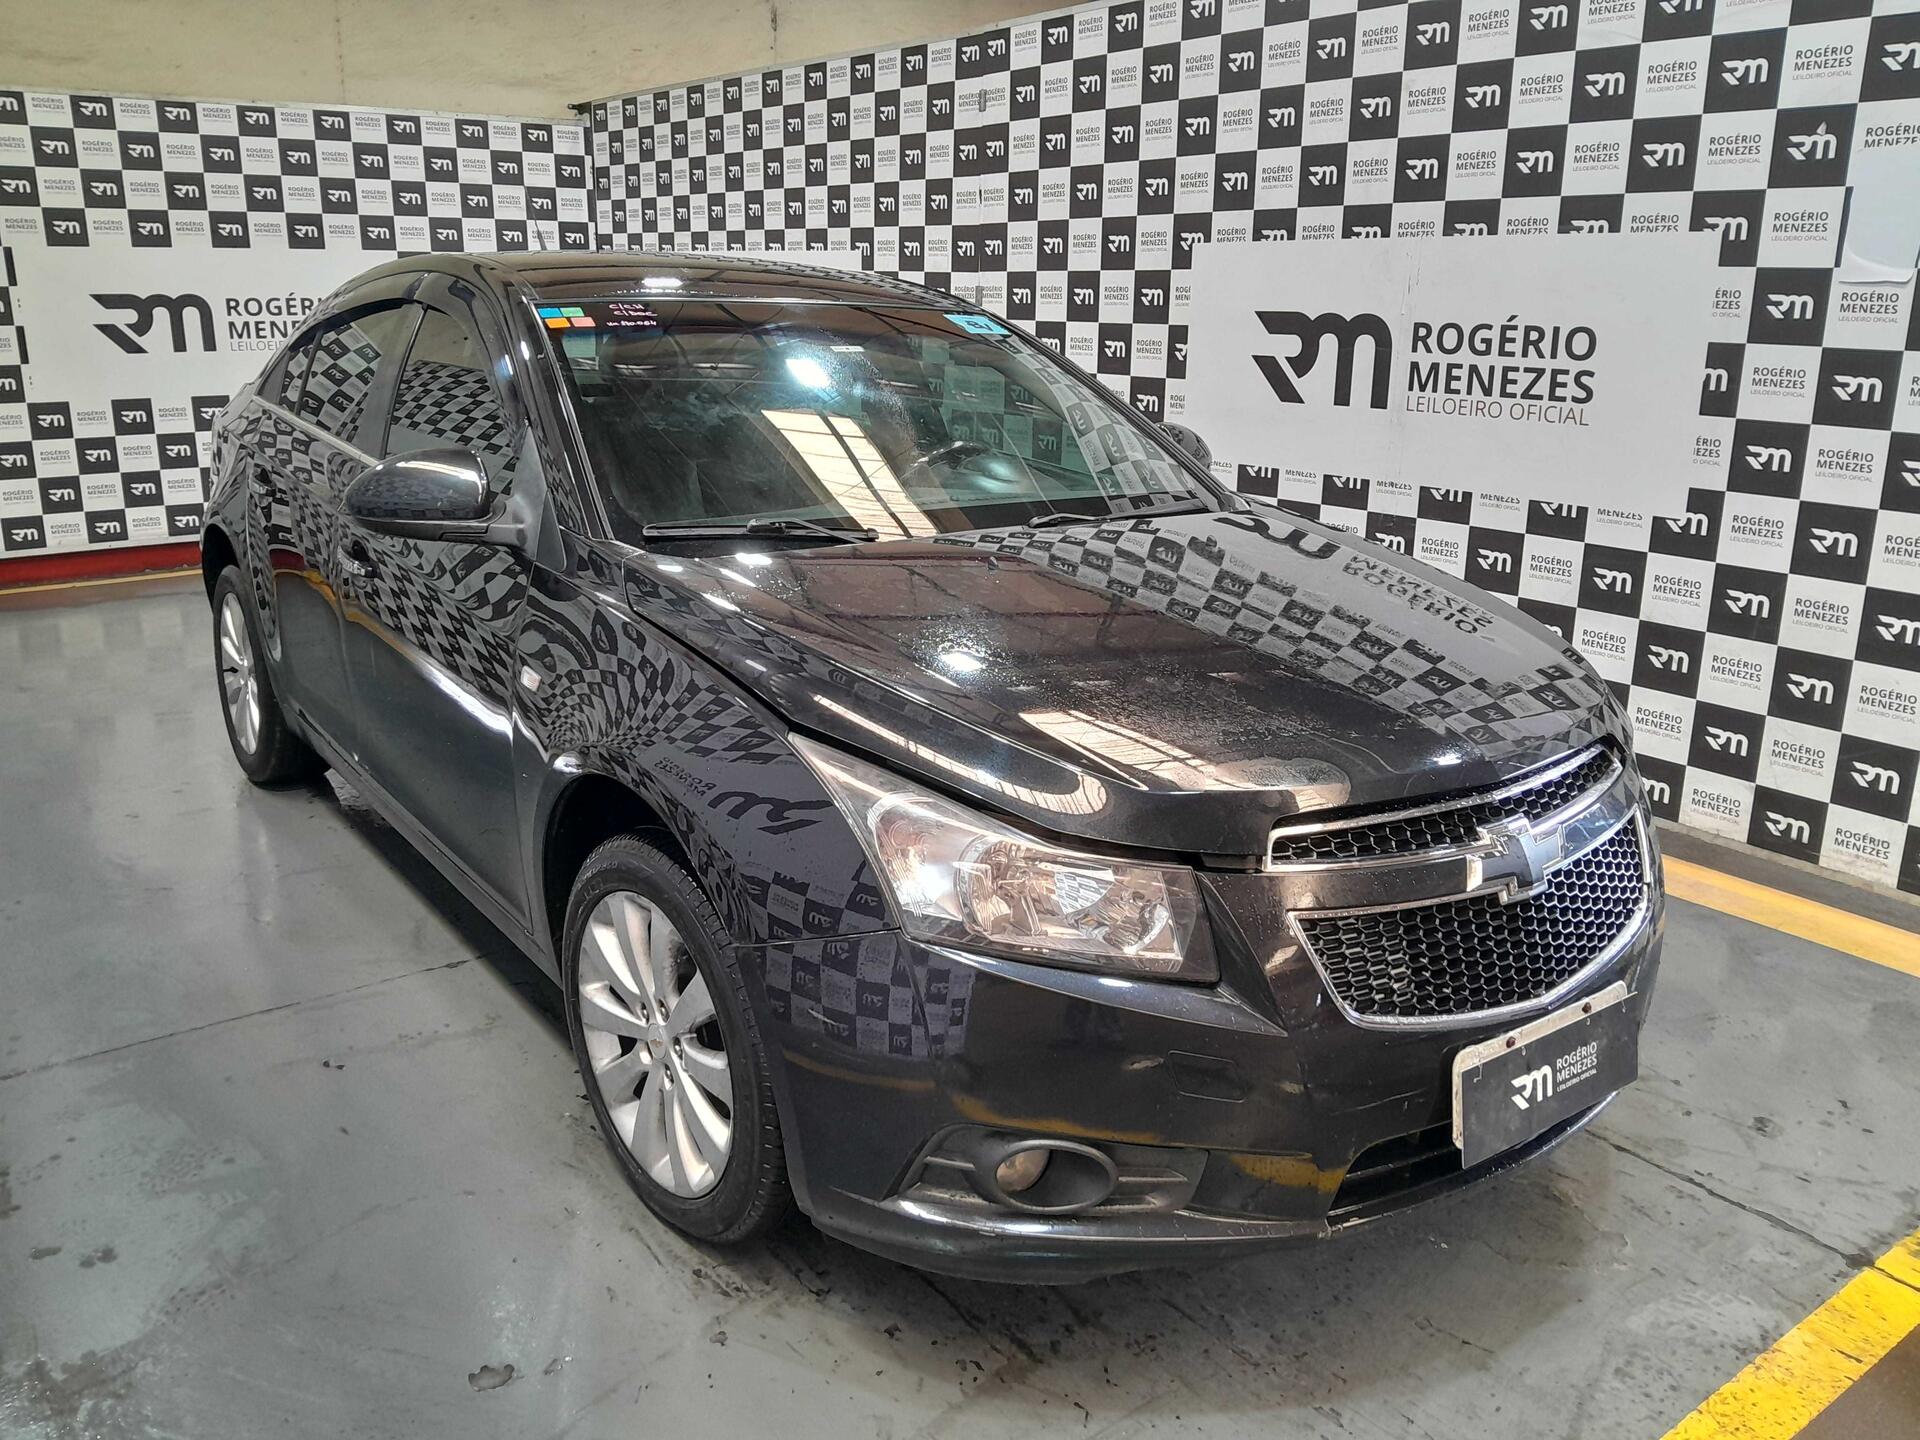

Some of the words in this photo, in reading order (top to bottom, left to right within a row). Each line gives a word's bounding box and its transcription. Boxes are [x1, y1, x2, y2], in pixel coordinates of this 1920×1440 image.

[1469, 9, 1509, 23] ROGÉRIO
[1468, 19, 1509, 32] MENEZES
[1269, 40, 1300, 52] ROGÉRIO
[1796, 44, 1853, 60] ROGÉRIO
[1268, 49, 1300, 61] MENEZES
[1648, 60, 1697, 74] ROGÉRIO
[1794, 56, 1852, 71] MENEZES
[1520, 74, 1563, 87] ROGÉRIO
[1647, 71, 1697, 84] MENEZES
[1409, 86, 1446, 98] ROGÉRIO
[1519, 84, 1563, 96] MENEZES
[1310, 97, 1343, 109] ROGÉRIO
[1408, 96, 1446, 107] MENEZES
[1310, 107, 1343, 117] MENEZES
[1709, 133, 1761, 146] ROGÉRIO
[1574, 141, 1620, 154] ROGÉRIO
[1708, 145, 1760, 156] MENEZES
[1353, 157, 1388, 168] ROGÉRIO
[1457, 150, 1496, 161] ROGÉRIO
[1573, 153, 1619, 164] MENEZES
[1262, 164, 1293, 174] ROGÉRIO
[1353, 167, 1388, 177] MENEZES
[1456, 160, 1496, 170] MENEZES
[1261, 173, 1293, 183] MENEZES
[1774, 209, 1829, 222] ROGÉRIO
[1772, 222, 1828, 233] MENEZES
[1841, 290, 1900, 303] ROGÉRIO
[1840, 303, 1898, 314] MENEZES
[90, 293, 217, 354] RM
[1410, 315, 1597, 361] ROGÉRIO
[1251, 310, 1393, 410] RM
[1753, 366, 1806, 379] ROGÉRIO
[1407, 361, 1595, 404] MENEZES
[1751, 377, 1805, 390] MENEZES
[1405, 395, 1503, 420] LEILOEIRO
[1509, 402, 1590, 427] OFICIAL
[1818, 449, 1874, 463] ROGÉRIO
[1816, 459, 1873, 474] MENEZES
[1732, 514, 1784, 529] ROGÉRIO
[1731, 524, 1783, 540] MENEZES
[1531, 554, 1572, 568] ROGÉRIO
[1530, 563, 1572, 577] MENEZES
[1654, 574, 1701, 589] ROGÉRIO
[1653, 584, 1700, 599] MENEZES
[1795, 598, 1849, 615] ROGÉRIO
[1793, 608, 1848, 625] MENEZES
[1582, 629, 1626, 644] ROGÉRIO
[1581, 638, 1625, 654] MENEZES
[1712, 655, 1762, 672] ROGÉRIO
[1711, 664, 1761, 682] MENEZES
[1636, 707, 1682, 724] ROGÉRIO
[1634, 716, 1681, 734] MENEZES
[1773, 739, 1825, 759] ROGÉRIO
[1771, 749, 1824, 769] MENEZES
[1692, 788, 1740, 808] ROGÉRIO
[1690, 797, 1739, 817] MENEZES
[1836, 828, 1892, 850] ROGÉRIO
[1834, 837, 1890, 860] MENEZES
[1556, 1041, 1597, 1070] ROGÉRIO
[1556, 1053, 1597, 1083] MENEZES
[1511, 1065, 1553, 1110] RM
